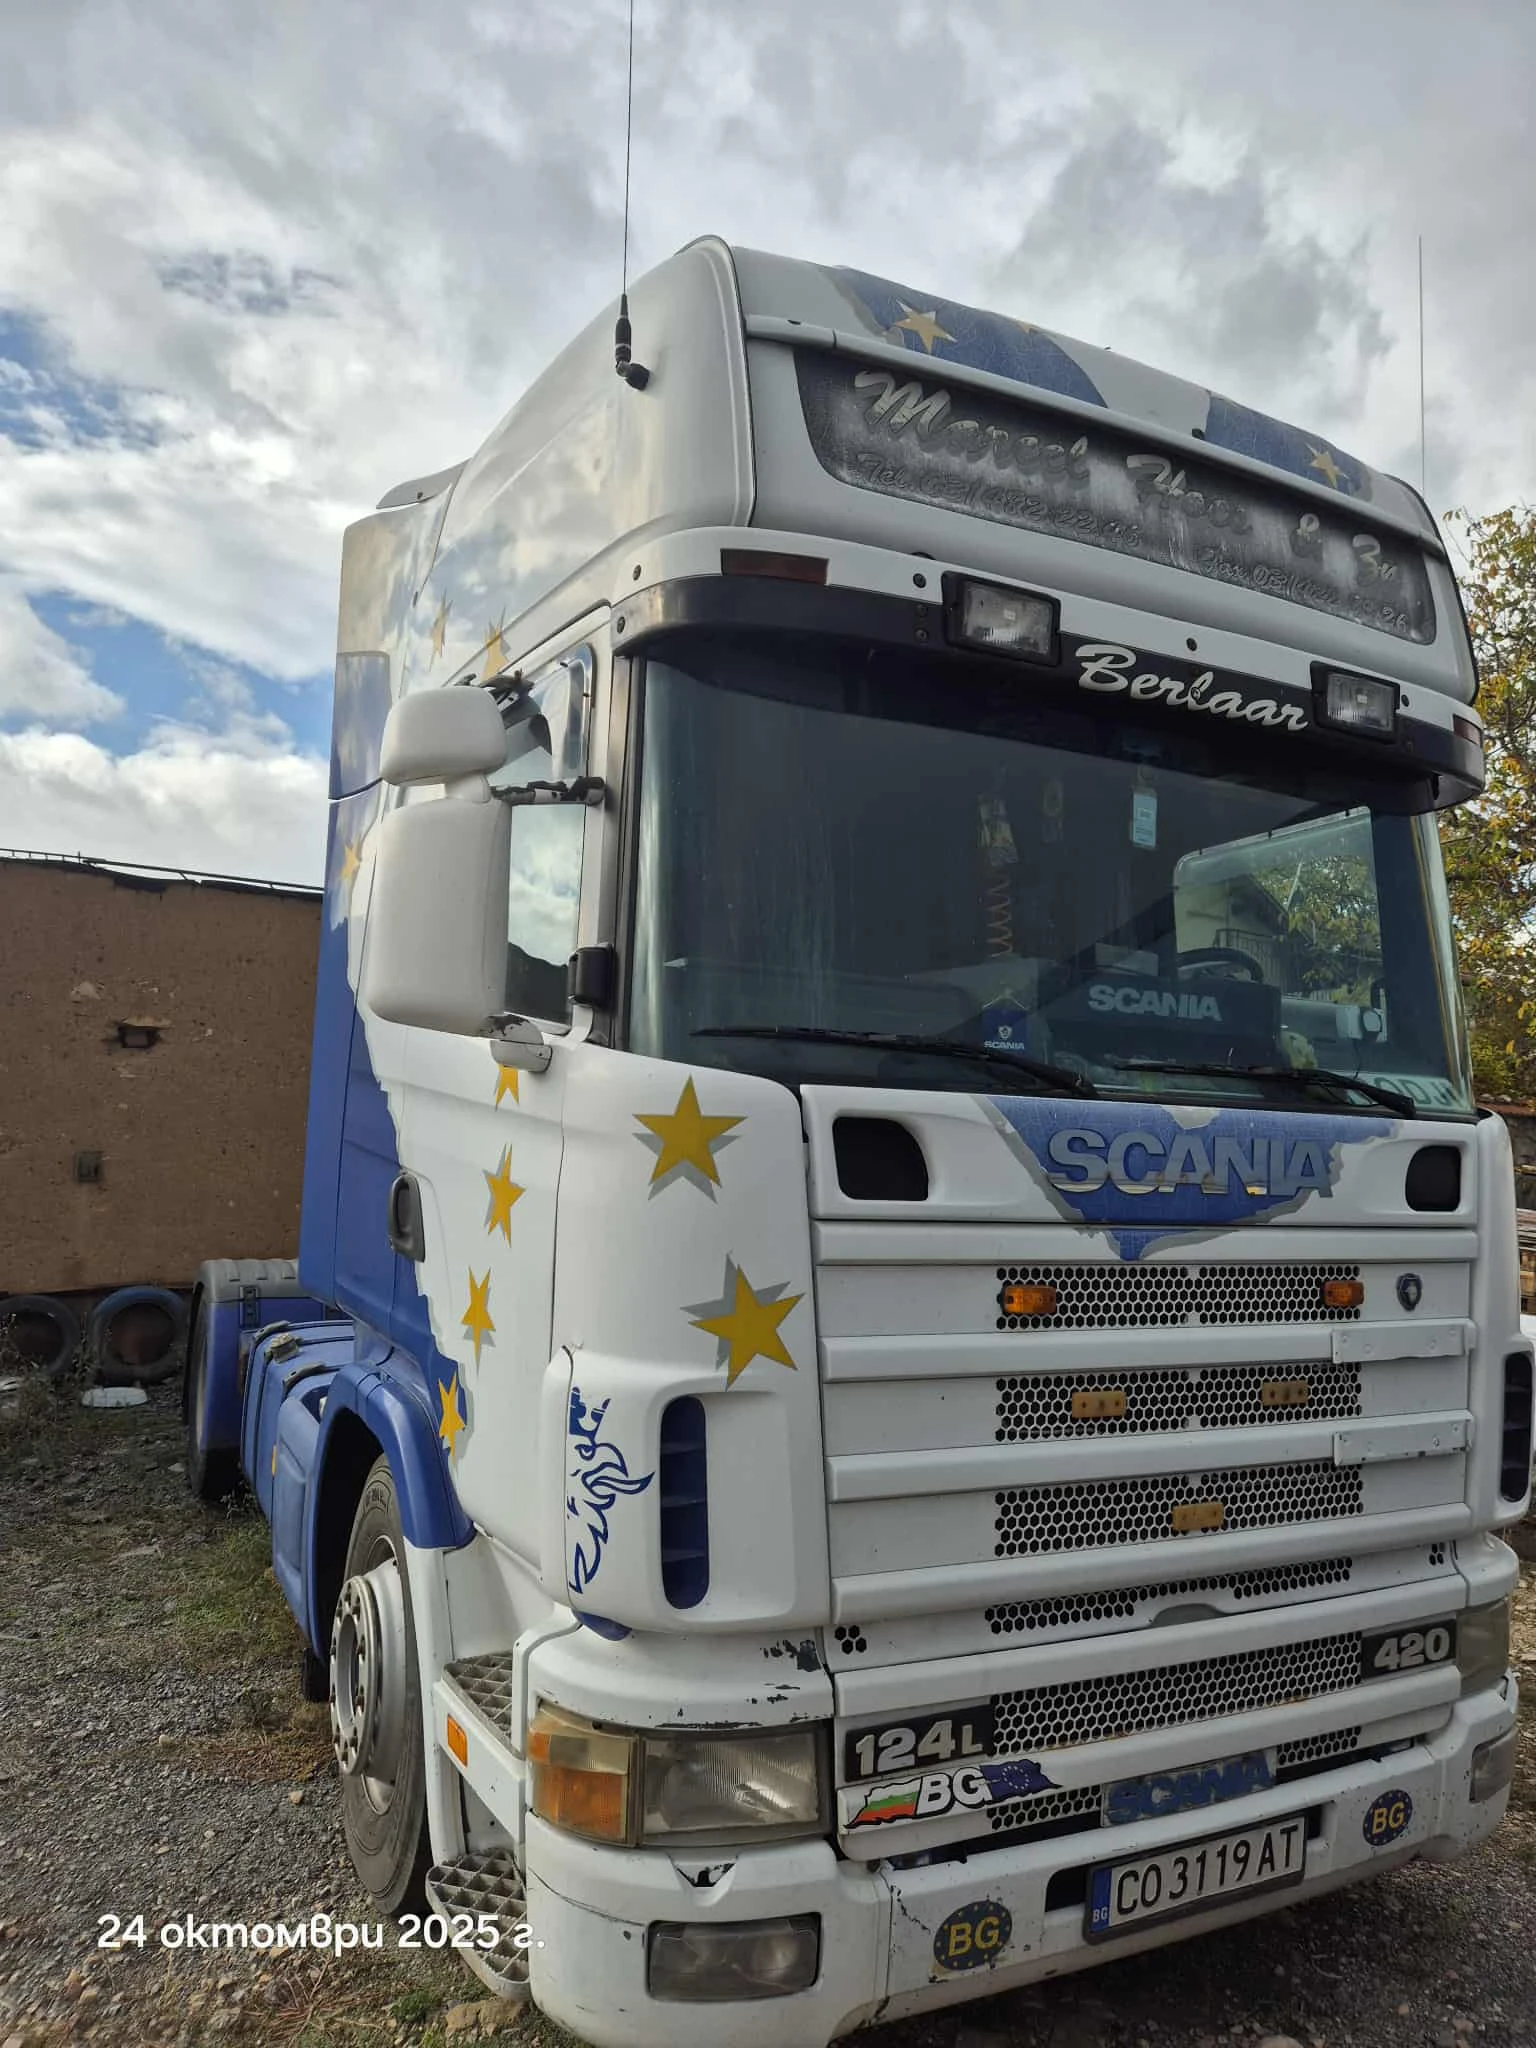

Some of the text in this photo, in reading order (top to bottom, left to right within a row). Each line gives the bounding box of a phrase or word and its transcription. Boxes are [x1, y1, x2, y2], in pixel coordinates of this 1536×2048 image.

[1075, 644, 1309, 731] Berlaar
[1088, 984, 1222, 1022] SCANIA
[983, 1040, 1026, 1050] SCANIA
[1048, 1128, 1334, 1198] SCANIA
[1373, 1626, 1450, 1672] 420
[915, 1766, 993, 1816] BG
[1371, 1801, 1405, 1834] BG
[1093, 1906, 1108, 1923] BG
[947, 1916, 1000, 1957] BG
